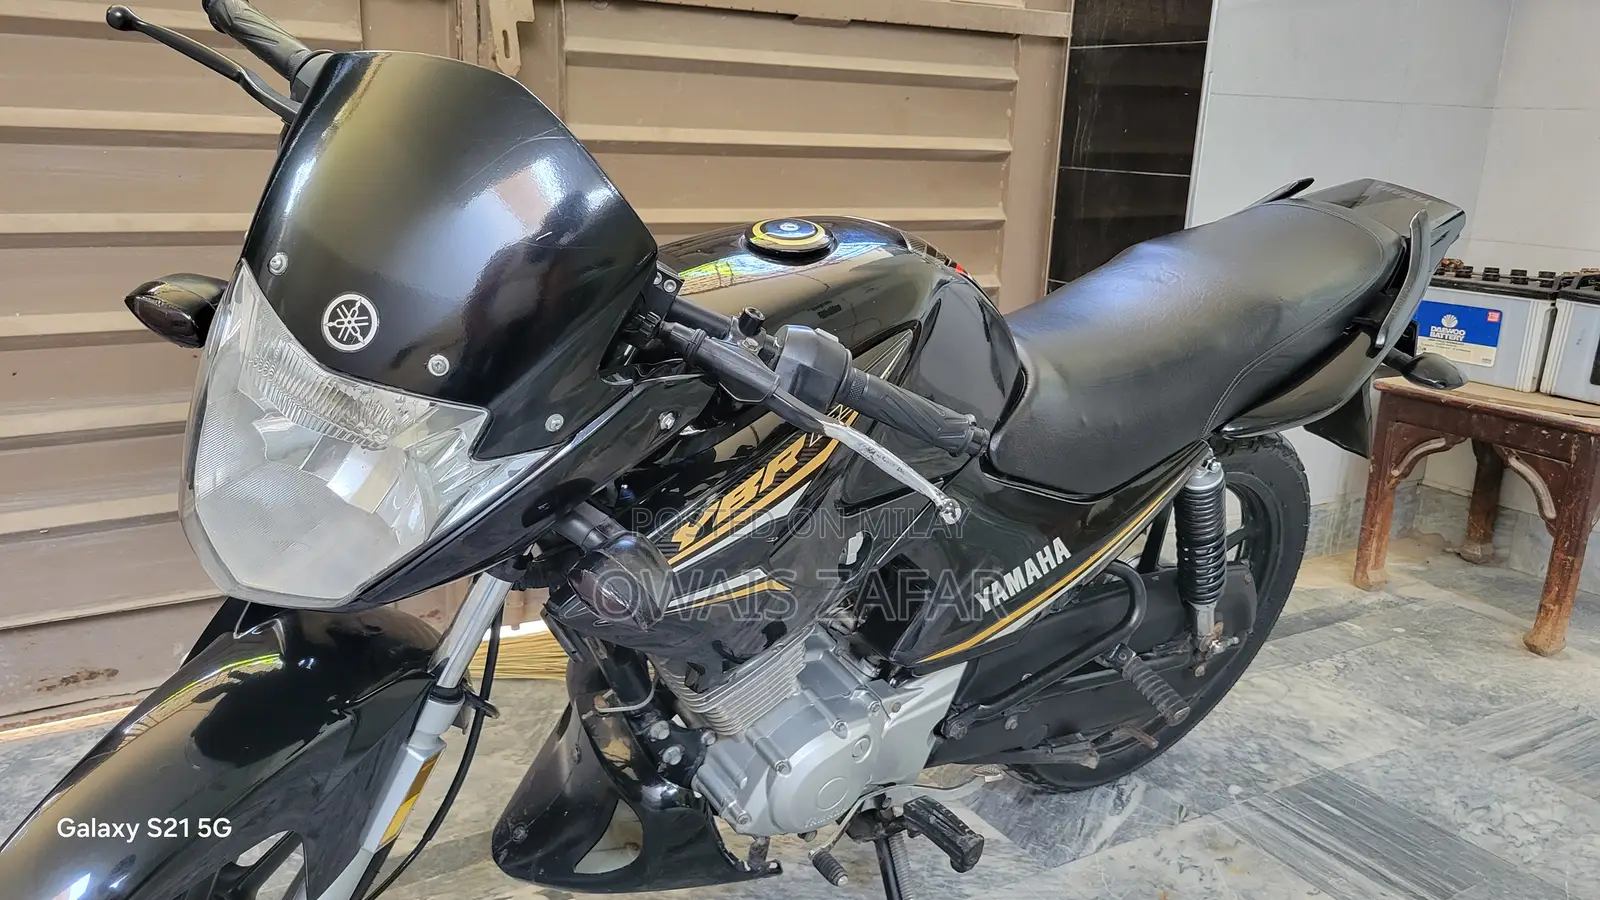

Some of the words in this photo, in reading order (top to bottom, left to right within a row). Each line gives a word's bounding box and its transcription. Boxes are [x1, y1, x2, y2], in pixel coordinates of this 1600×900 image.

[1429, 331, 1465, 341] BATTERY
[1430, 325, 1466, 336] DAEWOO
[974, 536, 1072, 613] YAMAHA
